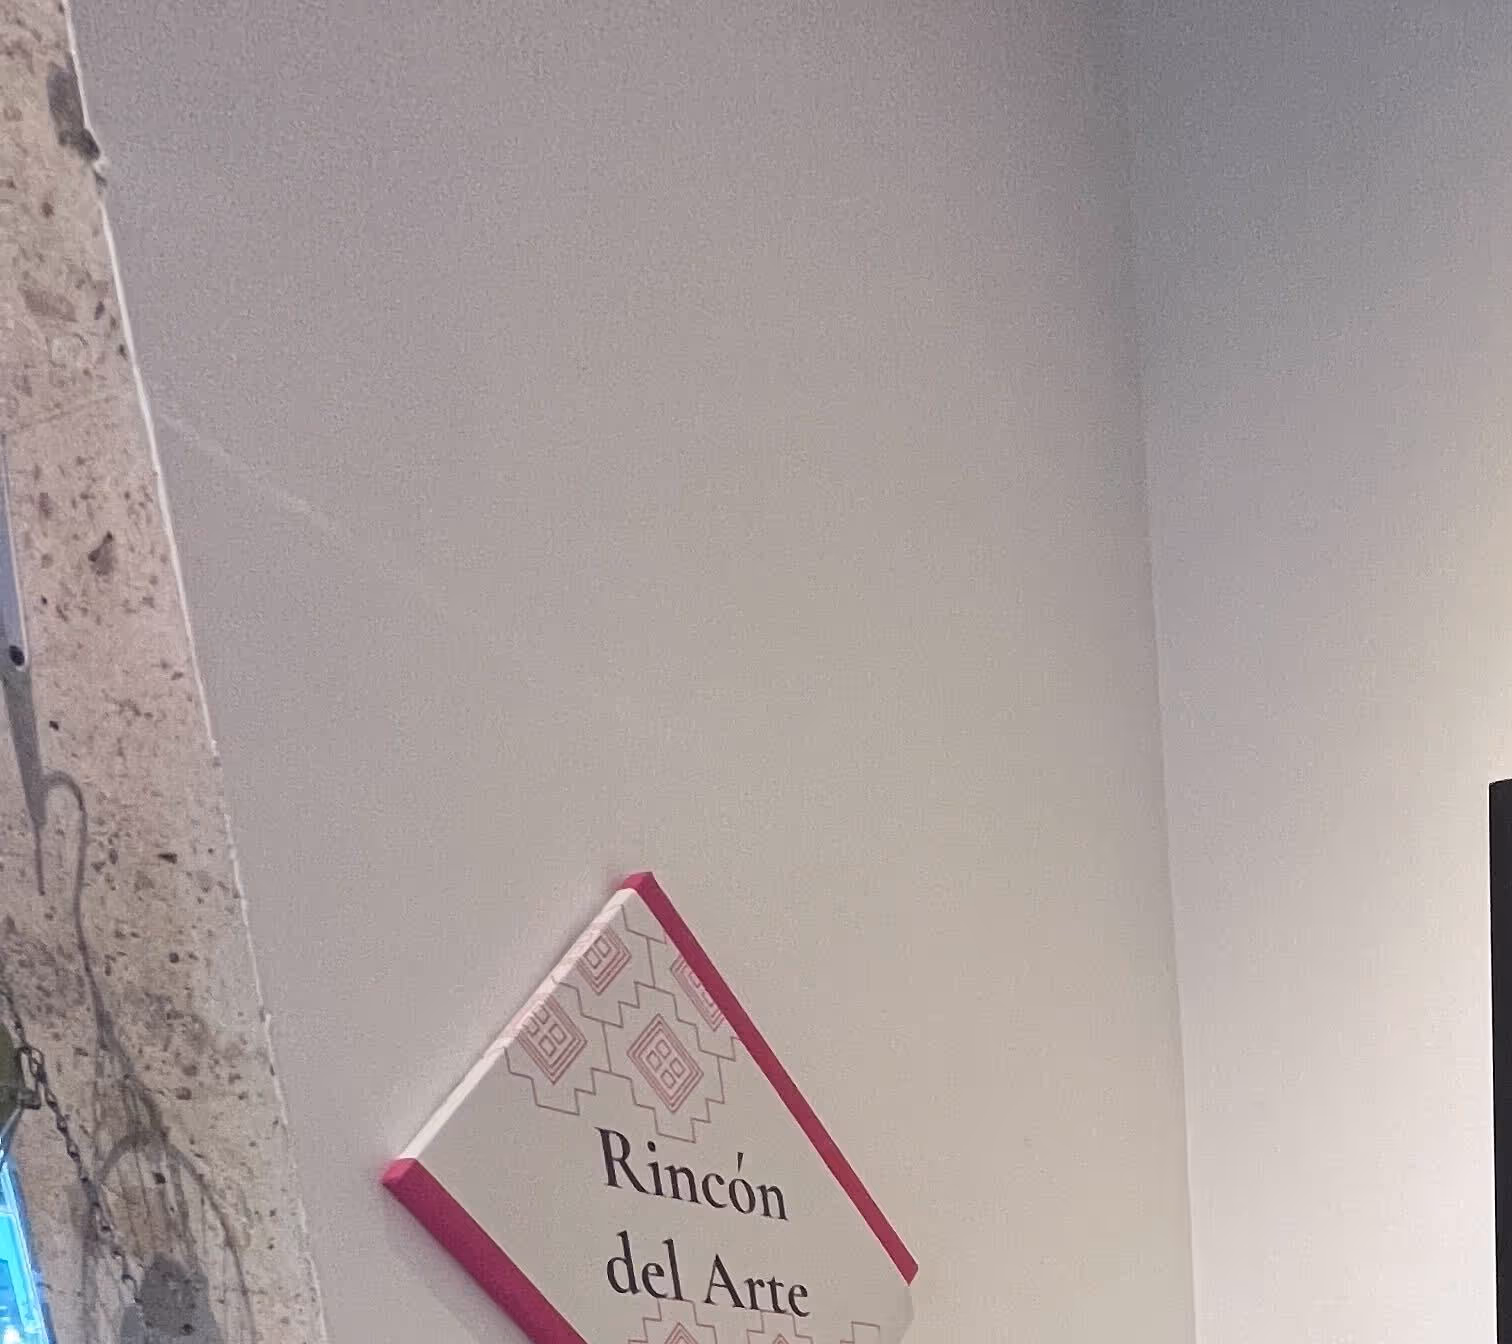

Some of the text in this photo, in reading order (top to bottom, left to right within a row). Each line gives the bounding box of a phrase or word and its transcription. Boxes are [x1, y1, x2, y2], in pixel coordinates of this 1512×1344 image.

[594, 1127, 788, 1220] Rincón
[606, 1230, 810, 1317] del Arte
